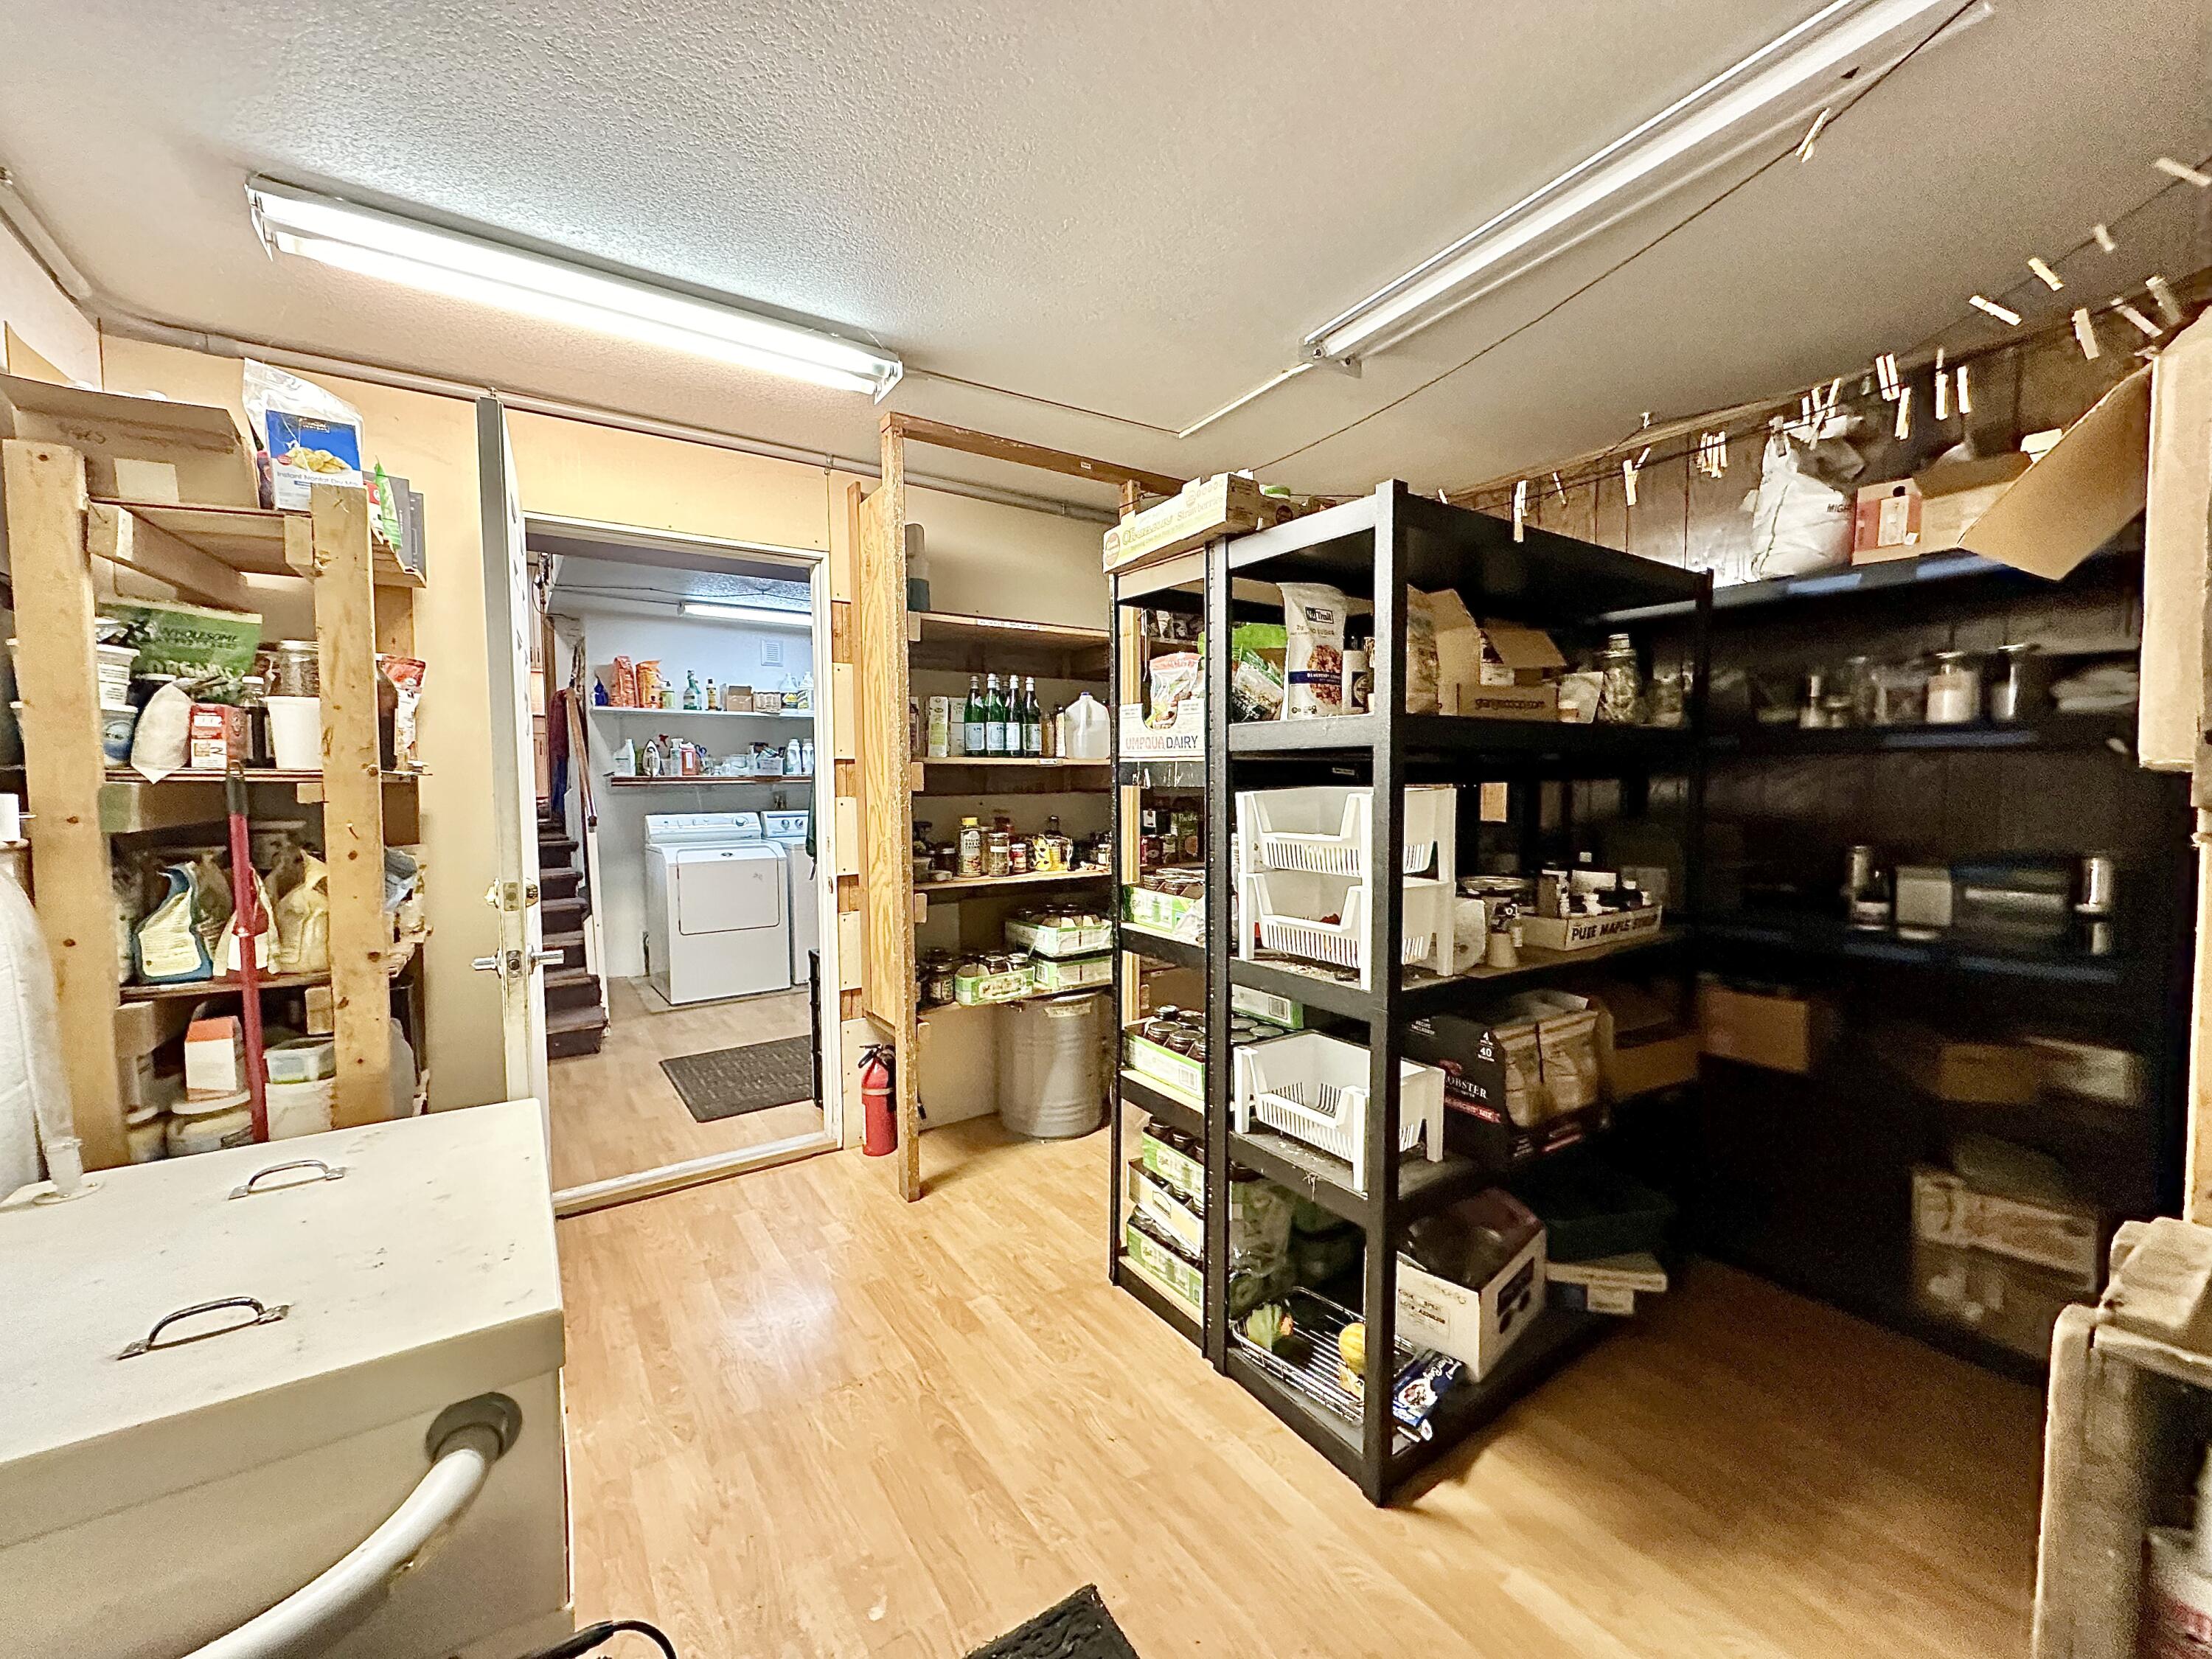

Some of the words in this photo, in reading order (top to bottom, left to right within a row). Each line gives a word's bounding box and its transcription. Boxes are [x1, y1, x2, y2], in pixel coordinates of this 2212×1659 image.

[1125, 737, 1164, 750] UMPQUA
[1166, 735, 1198, 749] DAIRY
[1482, 1032, 1489, 1040] 4
[1480, 1047, 1492, 1057] 40
[1445, 1076, 1488, 1099] OBSTER
